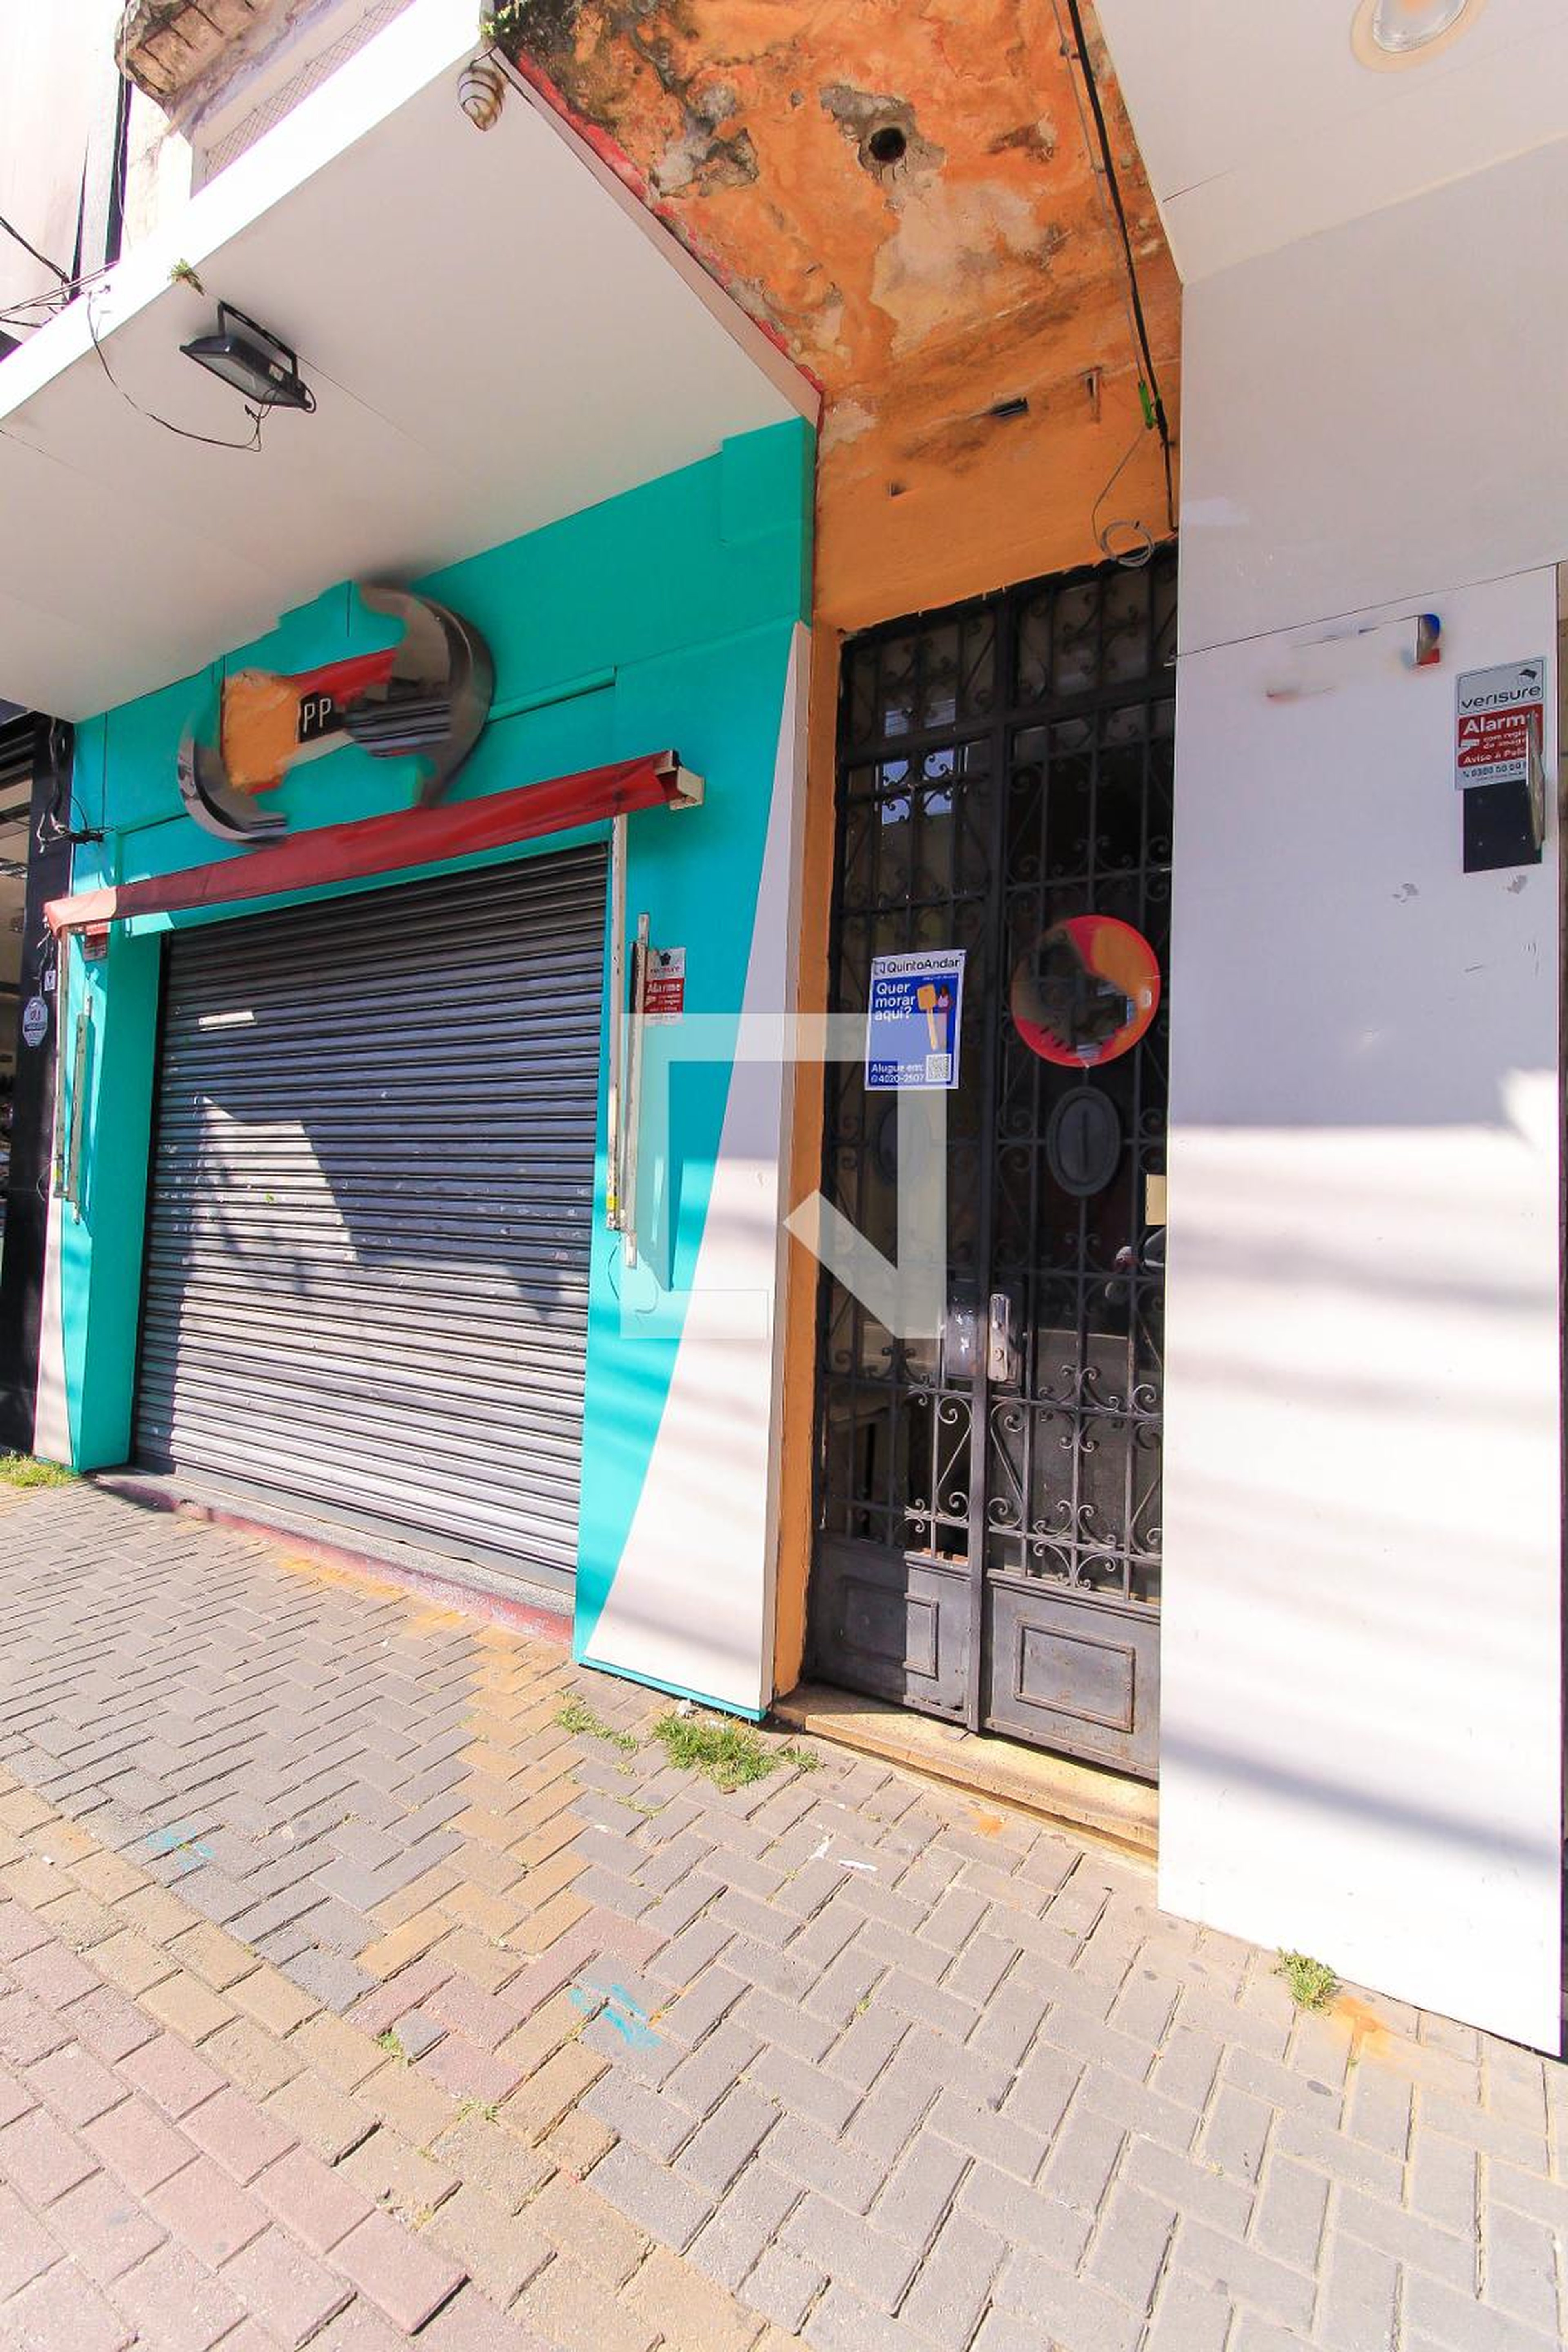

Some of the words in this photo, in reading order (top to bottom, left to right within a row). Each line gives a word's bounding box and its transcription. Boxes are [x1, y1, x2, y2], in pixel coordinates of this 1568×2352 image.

[1461, 686, 1541, 709] verisure
[1463, 754, 1492, 765] Aviso
[887, 958, 960, 973] QuintoAndar
[877, 982, 911, 995] Quer
[875, 995, 915, 1008] morar
[875, 1006, 912, 1022] aqui?
